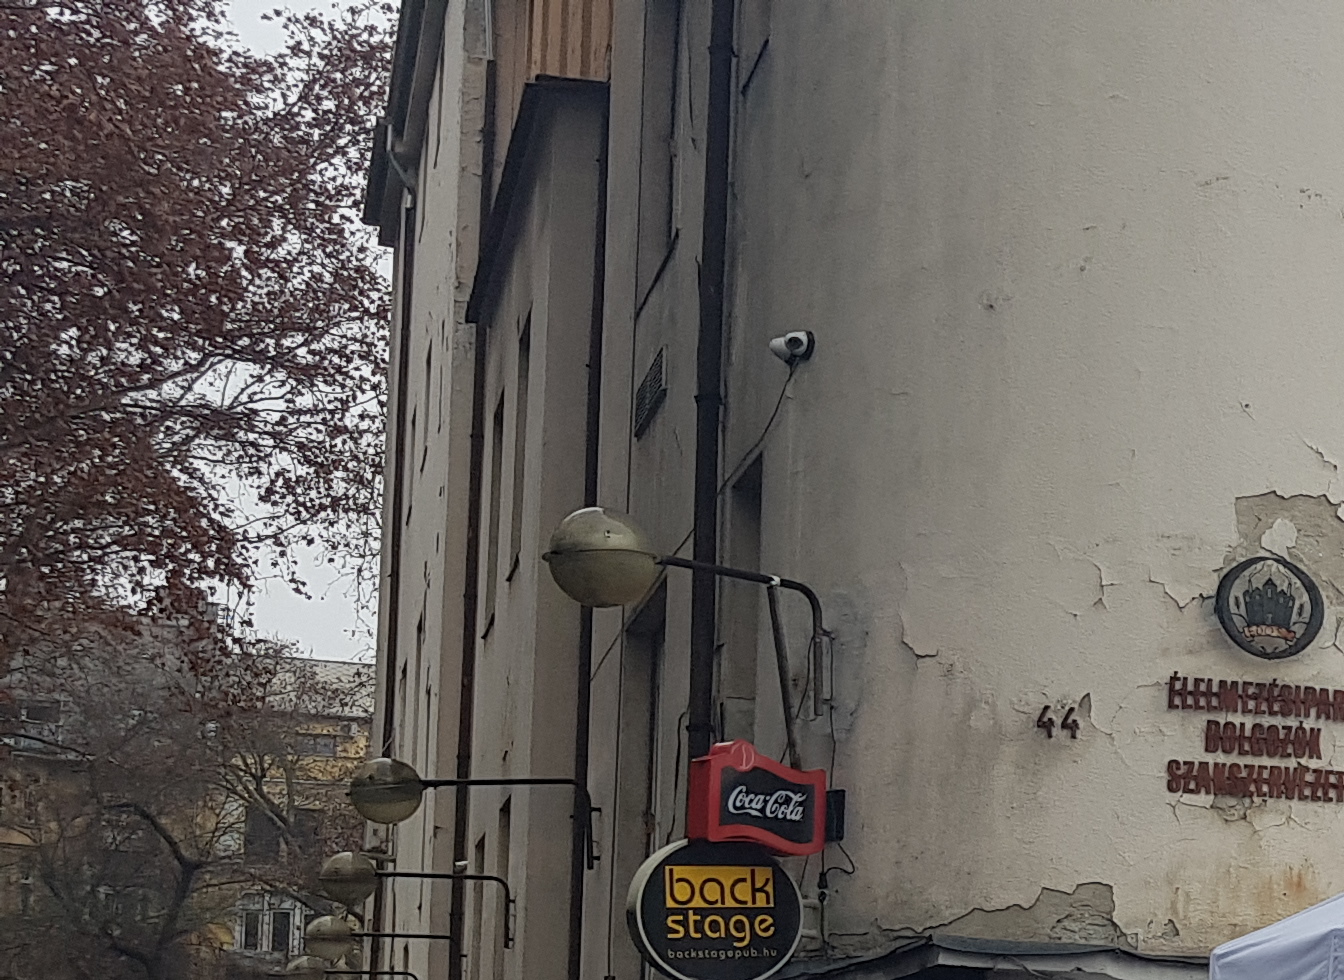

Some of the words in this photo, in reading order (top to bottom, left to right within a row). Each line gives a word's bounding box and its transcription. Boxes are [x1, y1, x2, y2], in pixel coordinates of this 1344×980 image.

[1036, 704, 1080, 740] 44
[1204, 719, 1323, 761] DOLGOZÓK
[728, 785, 808, 822] Coca-Cola
[668, 868, 773, 906] back
[666, 911, 776, 948] stage
[667, 947, 778, 961] backstagepub.hu
